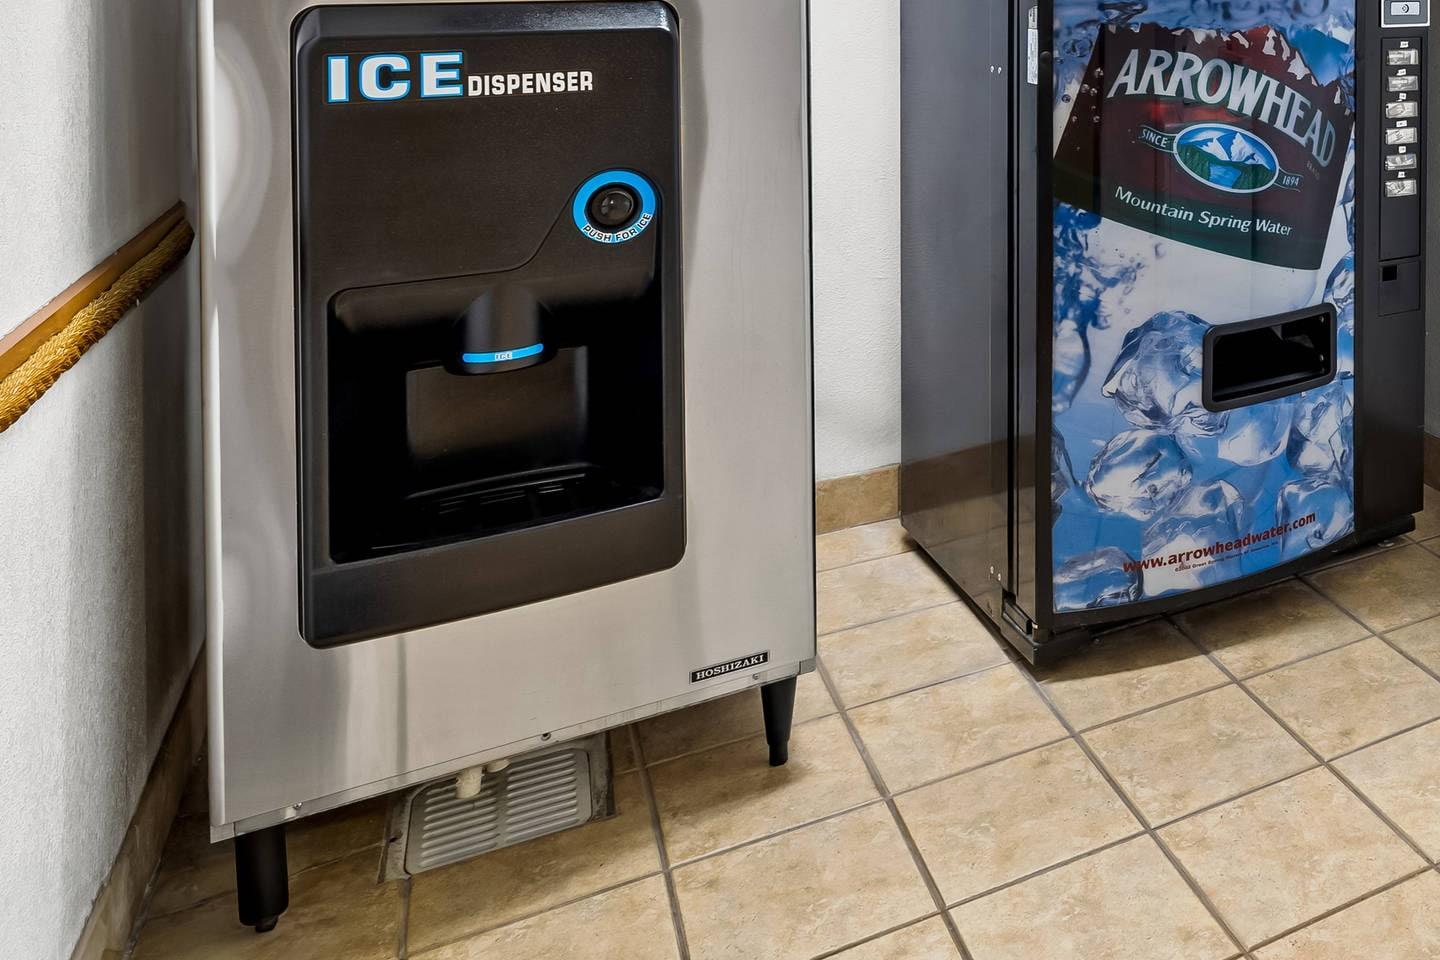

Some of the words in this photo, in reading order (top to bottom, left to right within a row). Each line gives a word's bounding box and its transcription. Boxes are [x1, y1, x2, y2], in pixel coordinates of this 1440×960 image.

[327, 51, 464, 103] ICE
[467, 71, 593, 96] DISPENSER
[1106, 48, 1337, 168] ARROWHEAD
[1141, 128, 1169, 148] SINCE
[1281, 174, 1301, 186] 1894
[1114, 186, 1194, 222] Mountain
[1198, 210, 1251, 233] Spring
[1255, 218, 1293, 236] Water
[581, 223, 613, 243] PUSH
[615, 227, 639, 242] FOR
[637, 213, 653, 229] ICE
[495, 352, 512, 360] ICE
[1122, 511, 1316, 573] www.arrowheadwater.com
[695, 654, 764, 681] HOSHIZAKI
